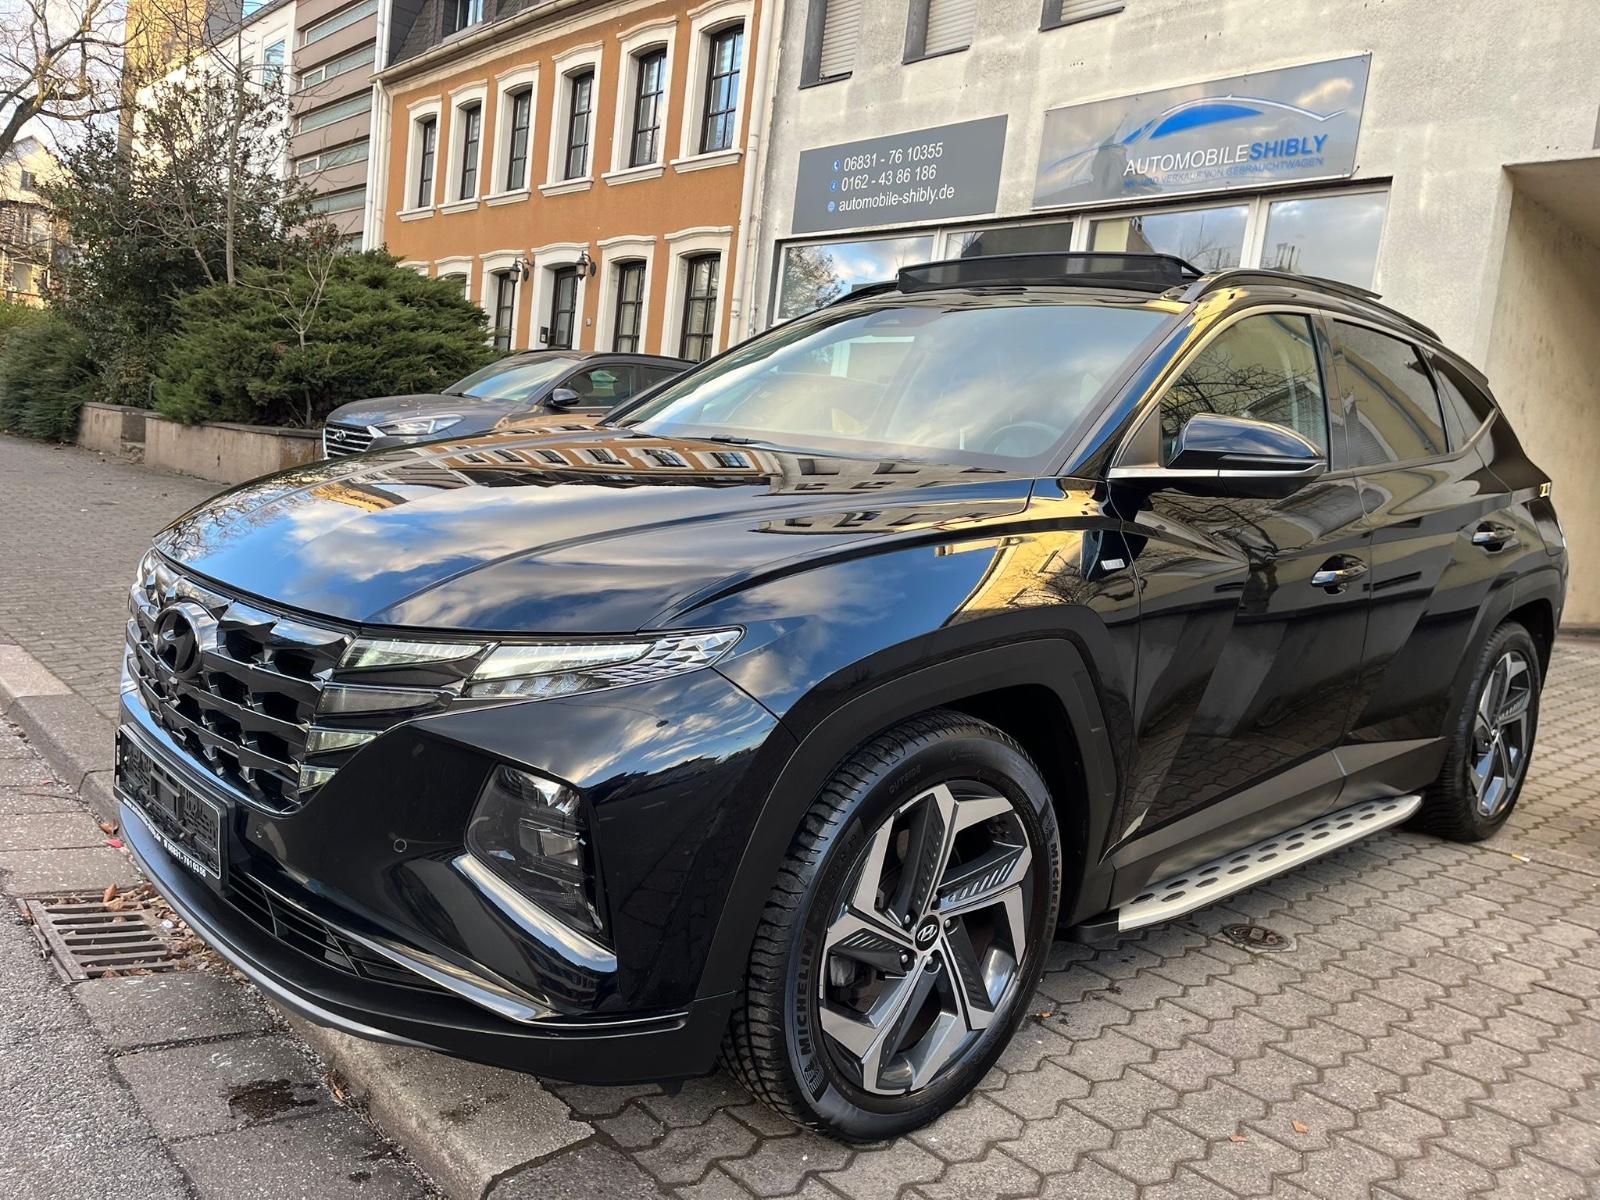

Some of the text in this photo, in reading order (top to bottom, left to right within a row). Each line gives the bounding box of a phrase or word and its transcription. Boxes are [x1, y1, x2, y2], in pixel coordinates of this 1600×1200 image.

[843, 152, 877, 172] 06831
[889, 149, 903, 165] 76
[907, 142, 944, 162] 10355
[841, 174, 869, 192] 0162
[878, 170, 893, 186] 43
[896, 168, 911, 184] 86
[915, 164, 937, 182] 186
[838, 184, 956, 212] automobile-shibly.de
[797, 943, 814, 1056] MICHELIN
